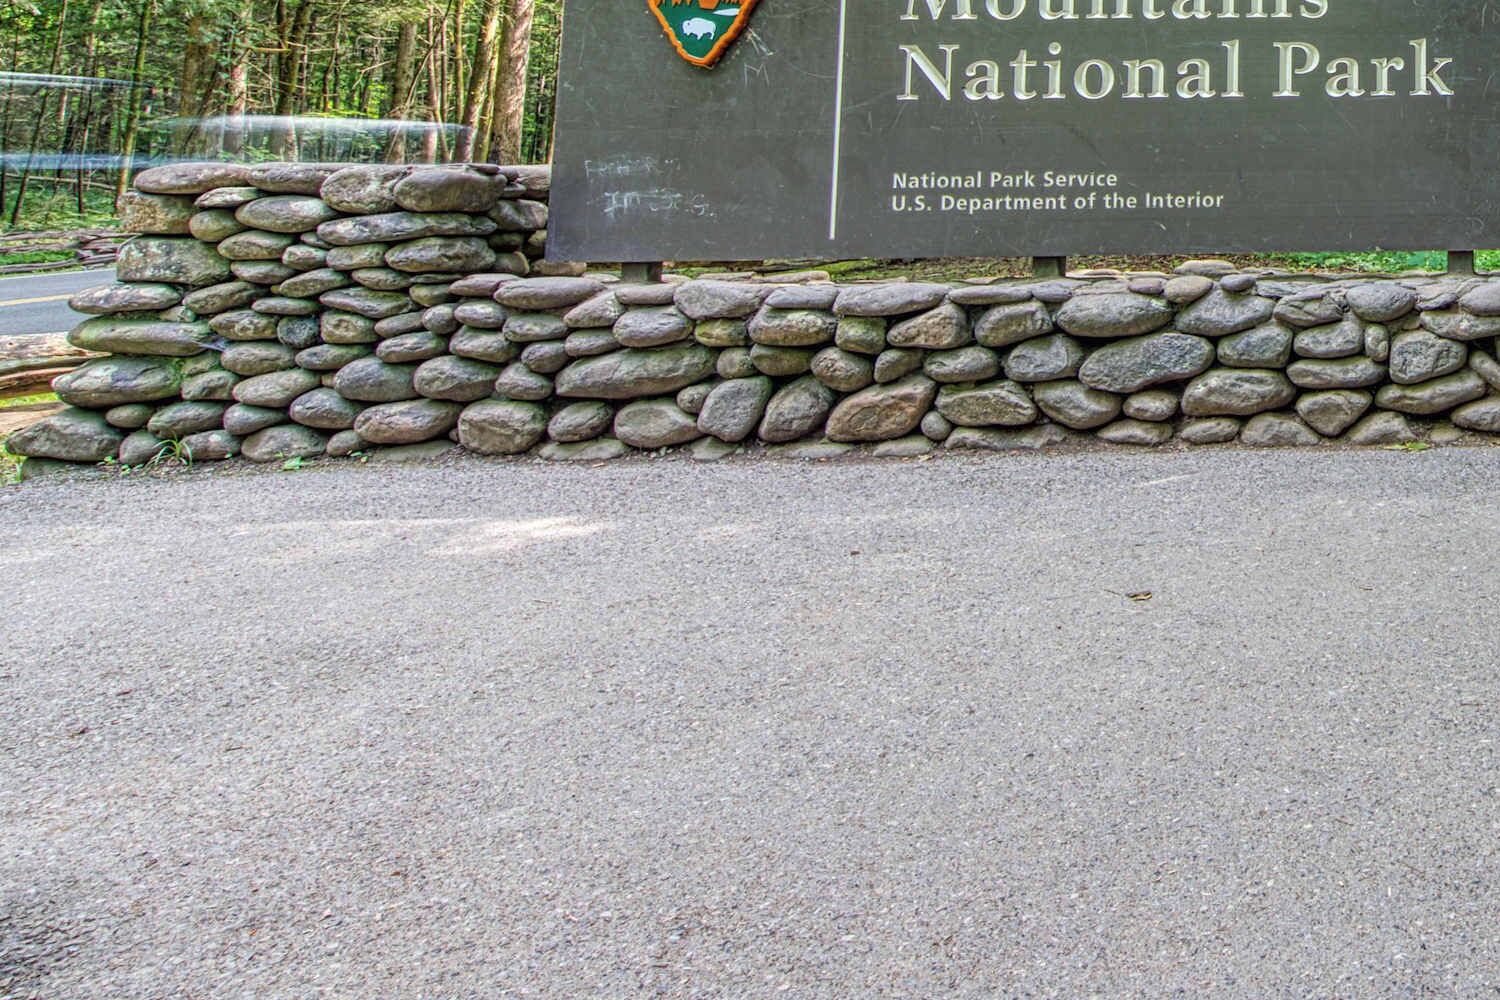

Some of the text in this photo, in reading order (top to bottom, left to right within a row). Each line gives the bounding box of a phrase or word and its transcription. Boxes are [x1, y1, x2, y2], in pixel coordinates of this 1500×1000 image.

[896, 37, 1456, 101] National Park
[892, 170, 1118, 189] National Park Service
[891, 191, 1224, 215] U.S. Department of the Interior
